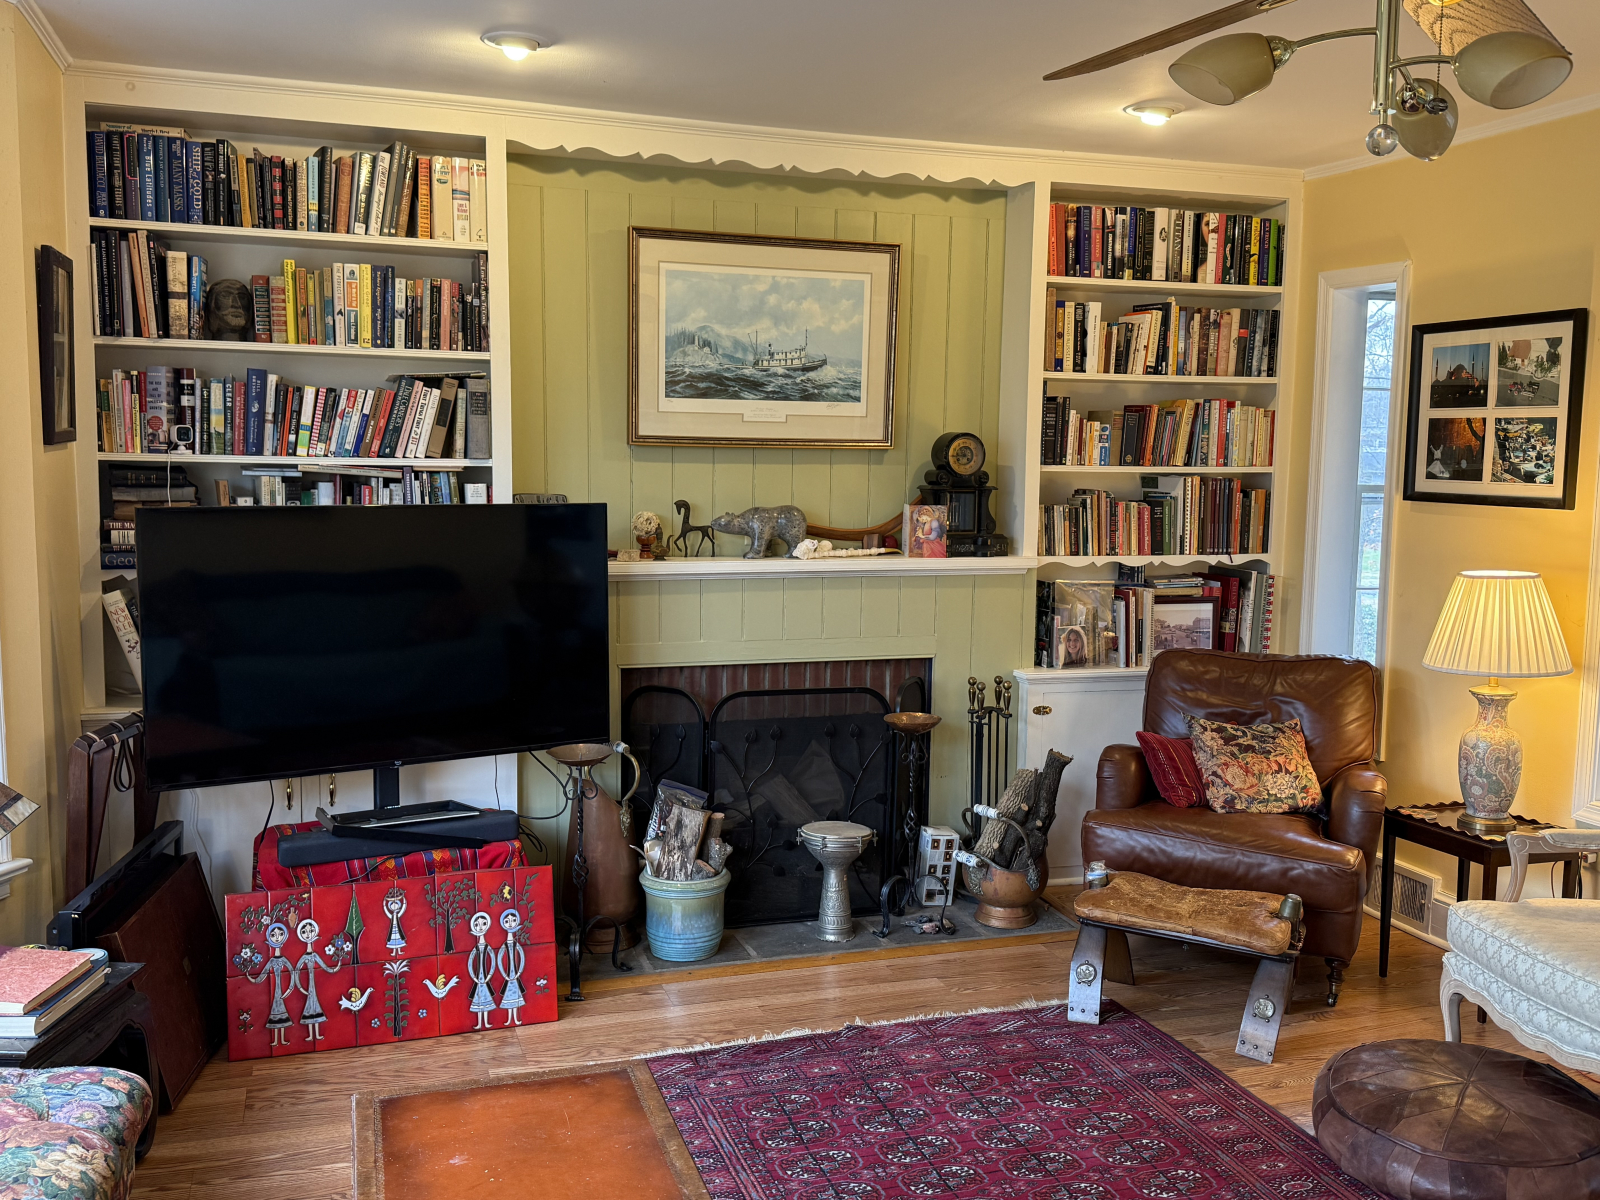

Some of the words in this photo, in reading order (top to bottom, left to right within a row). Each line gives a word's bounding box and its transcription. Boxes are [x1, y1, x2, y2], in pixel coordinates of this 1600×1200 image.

[94, 134, 103, 154] DAVID
[192, 146, 201, 172] SHIP
[96, 156, 105, 188] BALDACCI
[172, 159, 182, 183] MANY
[420, 162, 429, 186] CANADA
[114, 188, 122, 207] ERRORS
[173, 185, 183, 211] MASKS
[193, 180, 202, 209] GOLD
[420, 193, 429, 220] RICHARD
[421, 222, 429, 237] FORD
[1174, 219, 1182, 251] TITAN
[404, 386, 412, 399] DALE
[430, 395, 438, 411] blink
[415, 417, 424, 429] FIRST
[366, 426, 374, 443] AMERICA
[105, 554, 137, 567] Geo
